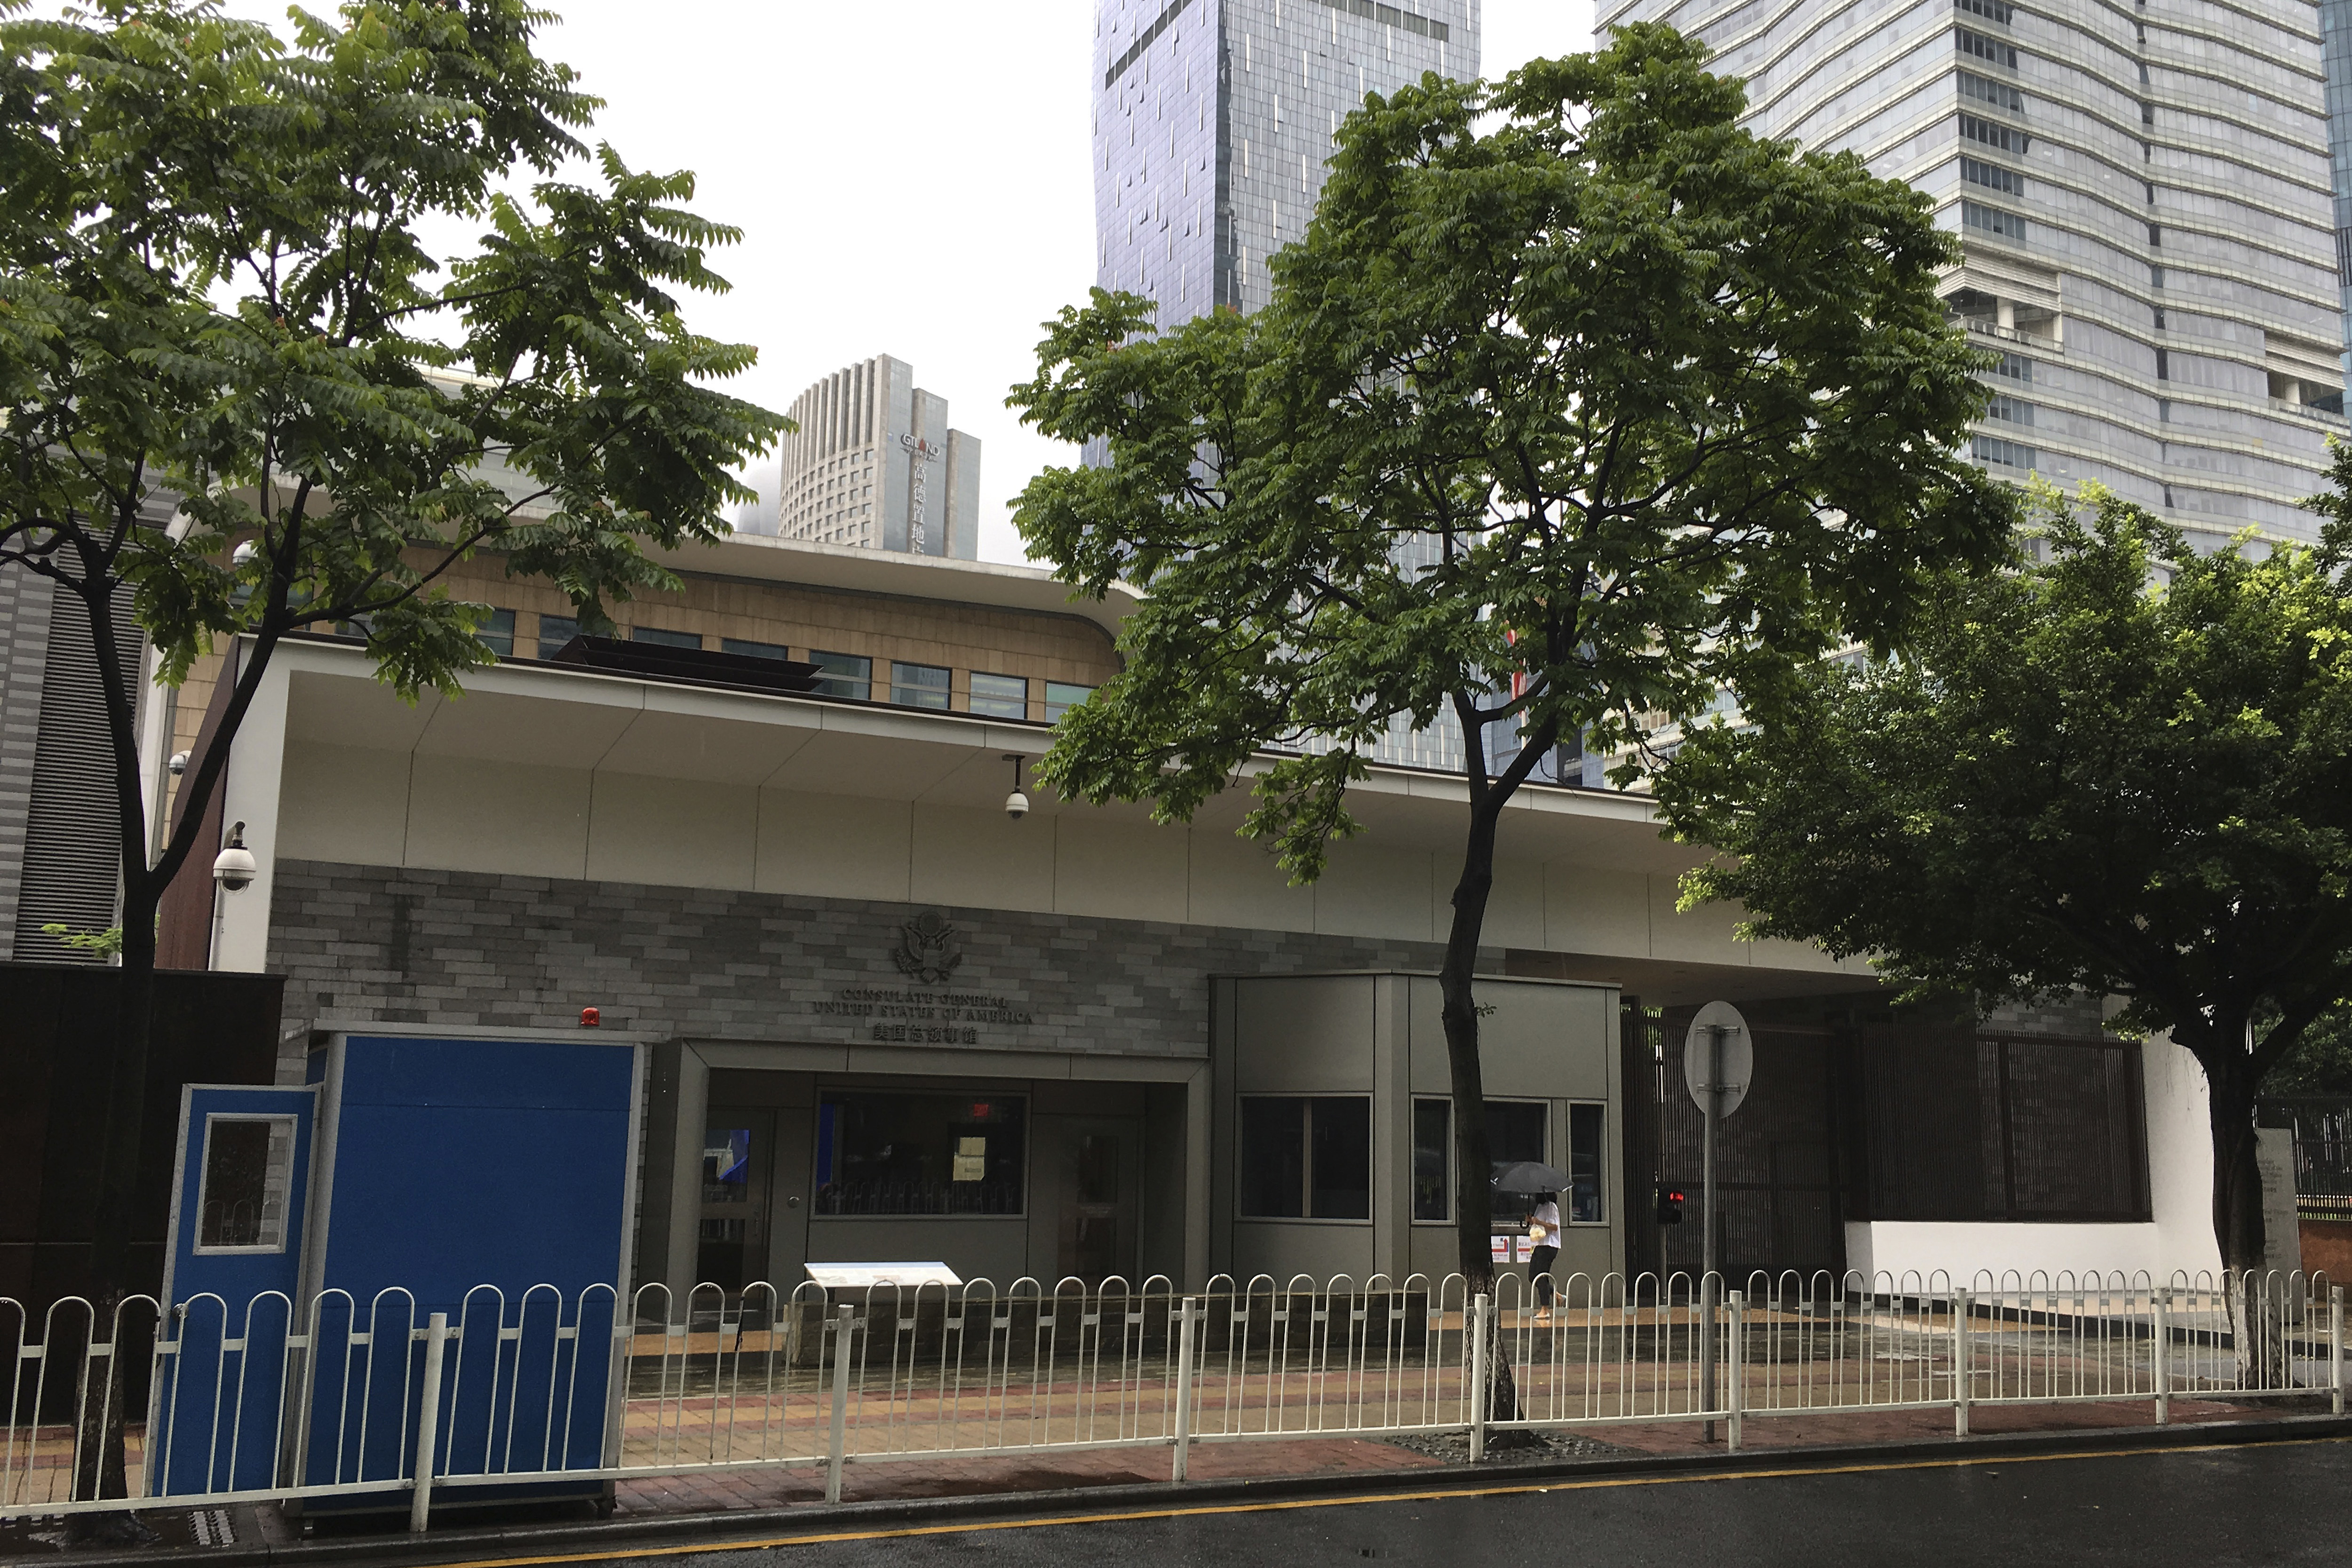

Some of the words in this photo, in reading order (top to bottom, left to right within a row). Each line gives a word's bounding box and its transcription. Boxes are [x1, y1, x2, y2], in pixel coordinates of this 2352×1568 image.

[842, 988, 933, 1004] CONSULATE
[941, 994, 1007, 1008] GENERAL
[813, 1002, 873, 1016] UNITED
[882, 1005, 935, 1018] STATES
[943, 1009, 960, 1019] OF
[967, 1010, 1033, 1025] AMERICA
[874, 1023, 978, 1043] 美国总领事馆
